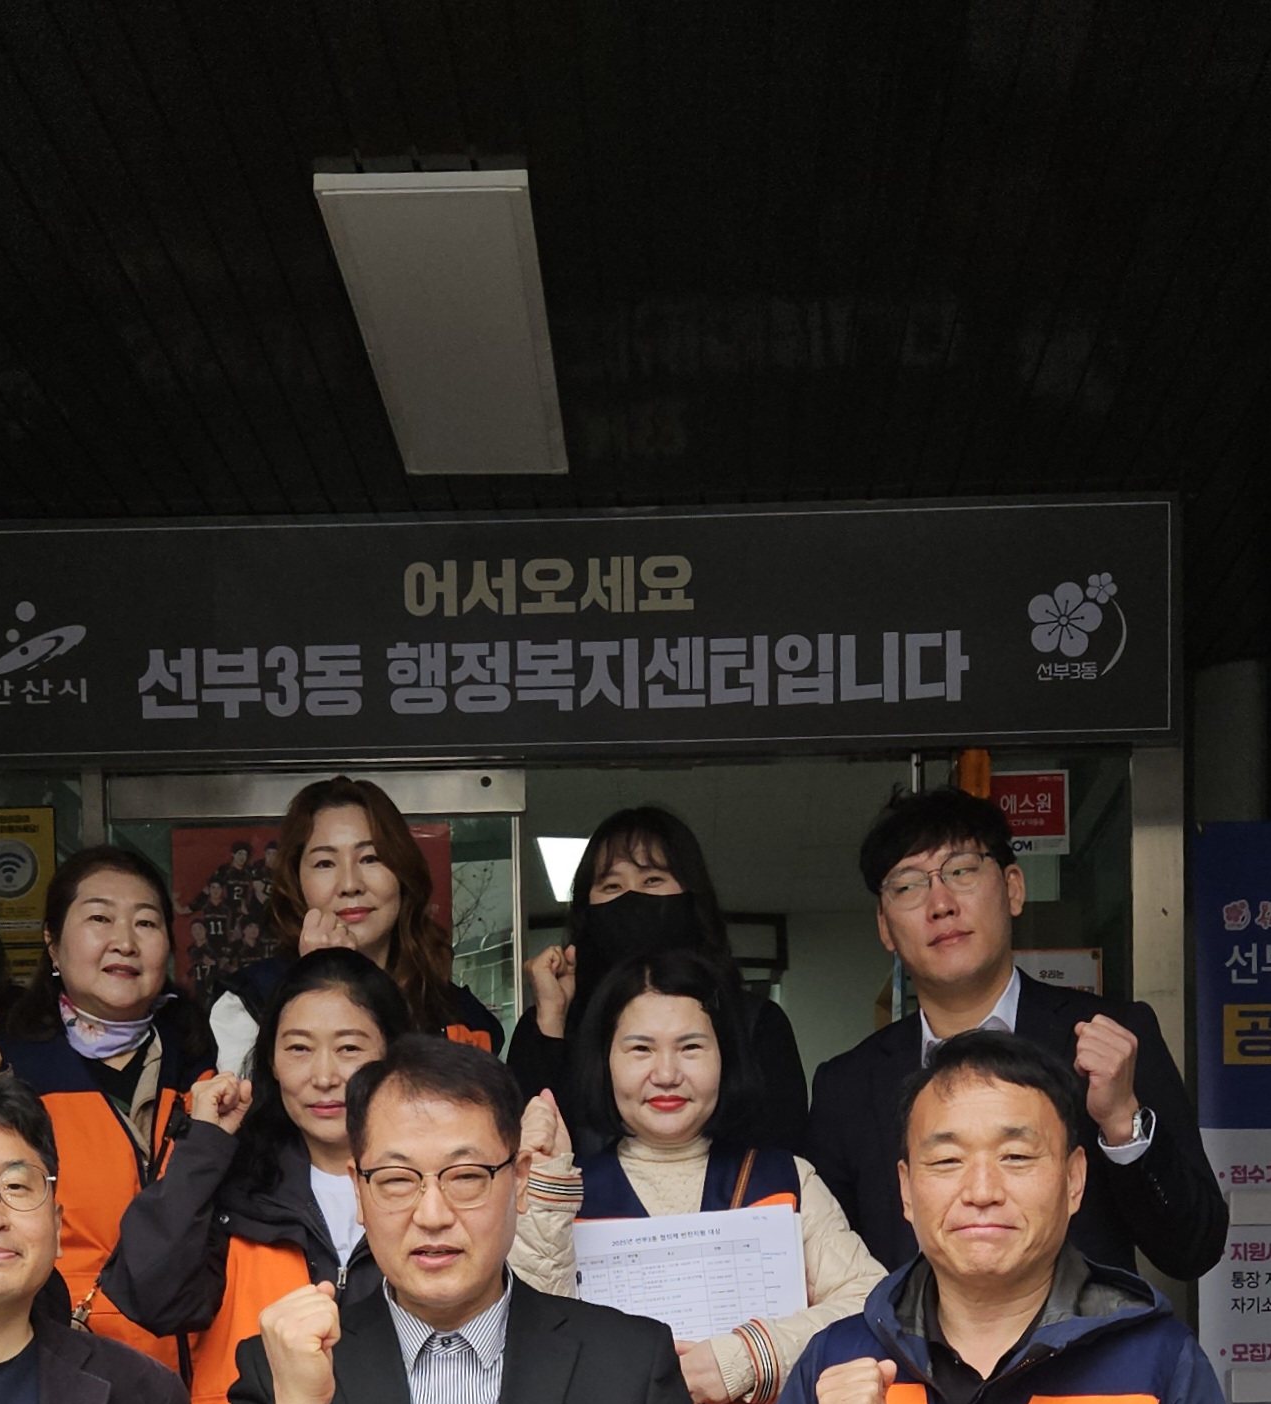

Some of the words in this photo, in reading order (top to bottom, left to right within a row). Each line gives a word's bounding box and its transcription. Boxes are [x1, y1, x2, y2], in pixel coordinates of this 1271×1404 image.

[404, 555, 695, 618] 어서오세요
[137, 643, 365, 720] 선부3동
[386, 630, 970, 716] 행정복지센터입니다
[1035, 660, 1099, 683] 선부3동
[999, 792, 1052, 814] 에스원
[209, 920, 224, 935] 11
[1231, 1270, 1261, 1289] 통장
